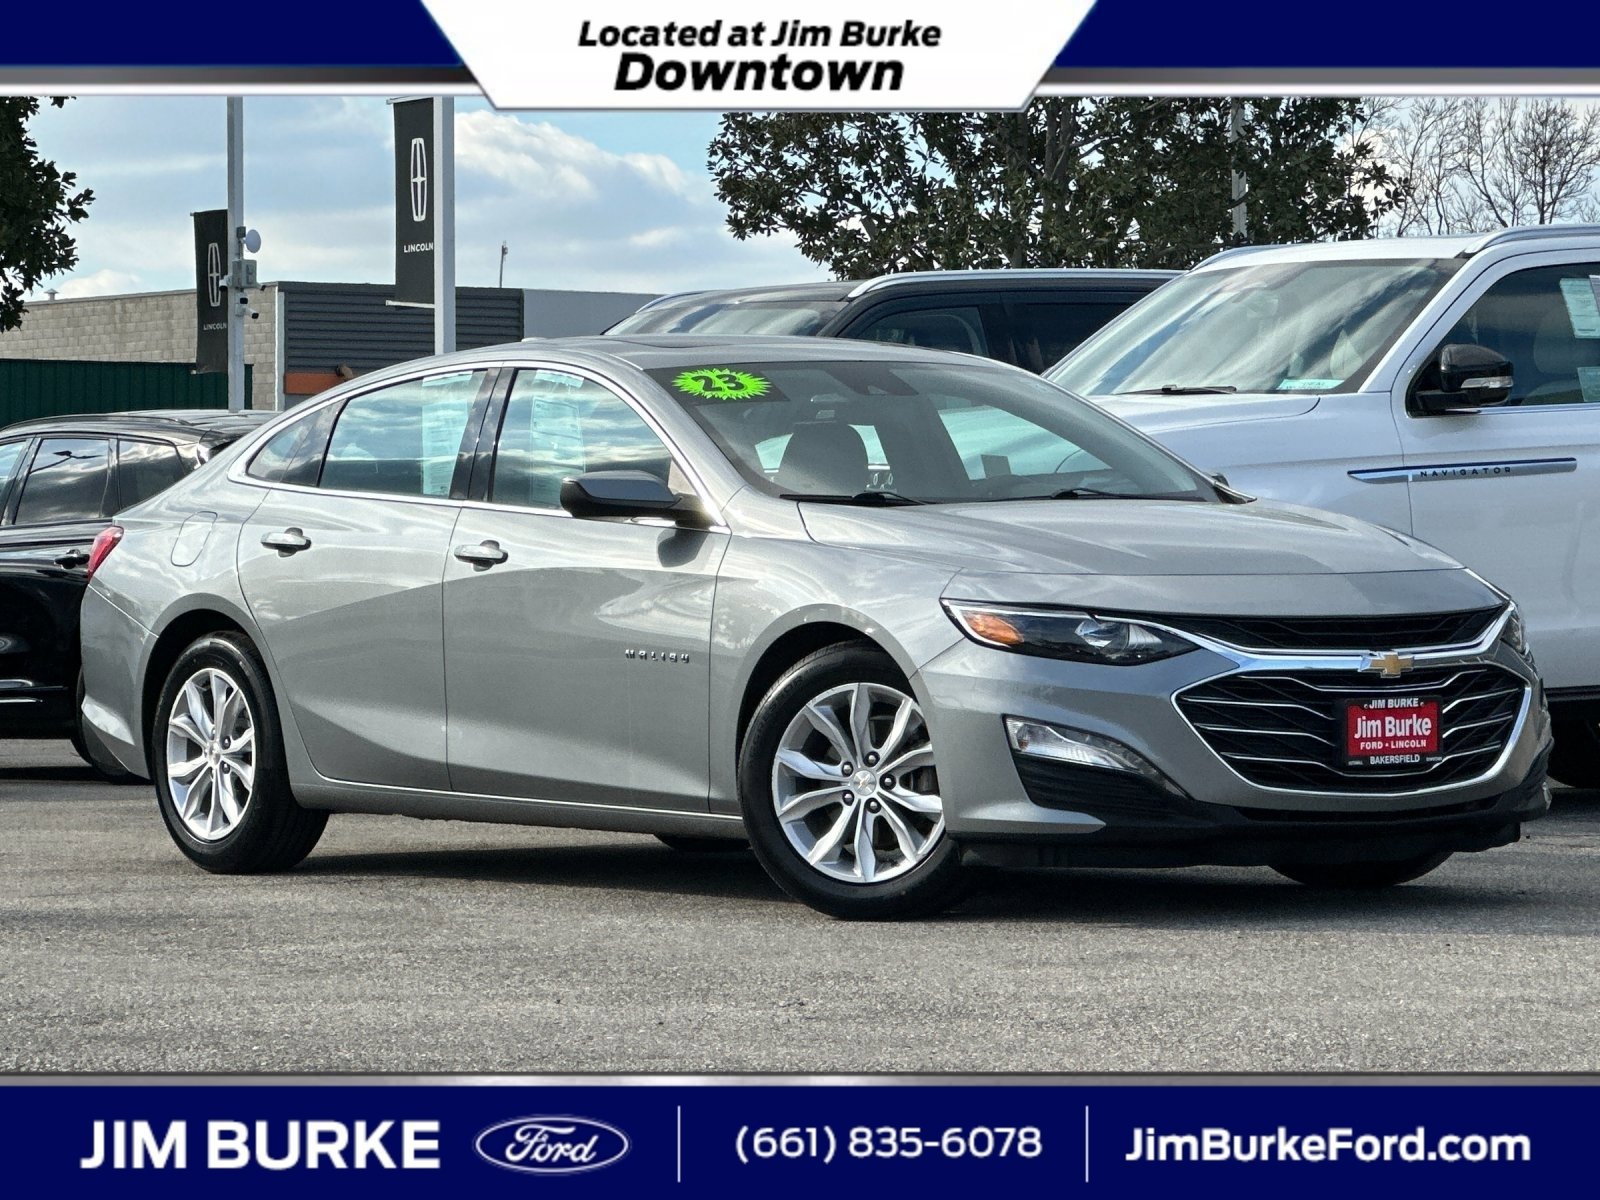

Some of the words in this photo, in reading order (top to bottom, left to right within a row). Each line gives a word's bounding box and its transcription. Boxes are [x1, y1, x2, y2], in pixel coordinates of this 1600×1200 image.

[403, 242, 434, 253] LINCOLN
[203, 322, 228, 331] LINCOLN
[691, 374, 745, 392] 23
[1420, 466, 1511, 478] NAVIGATOR
[625, 648, 690, 664] MALIBU
[1369, 699, 1385, 709] JIM
[1387, 698, 1419, 709] BURKE
[1354, 715, 1382, 739] Jim
[1384, 713, 1432, 737] Burke
[1360, 741, 1384, 750] FORD
[1390, 739, 1427, 749] LINCOLN
[1369, 754, 1421, 765] BAKERSFIELD
